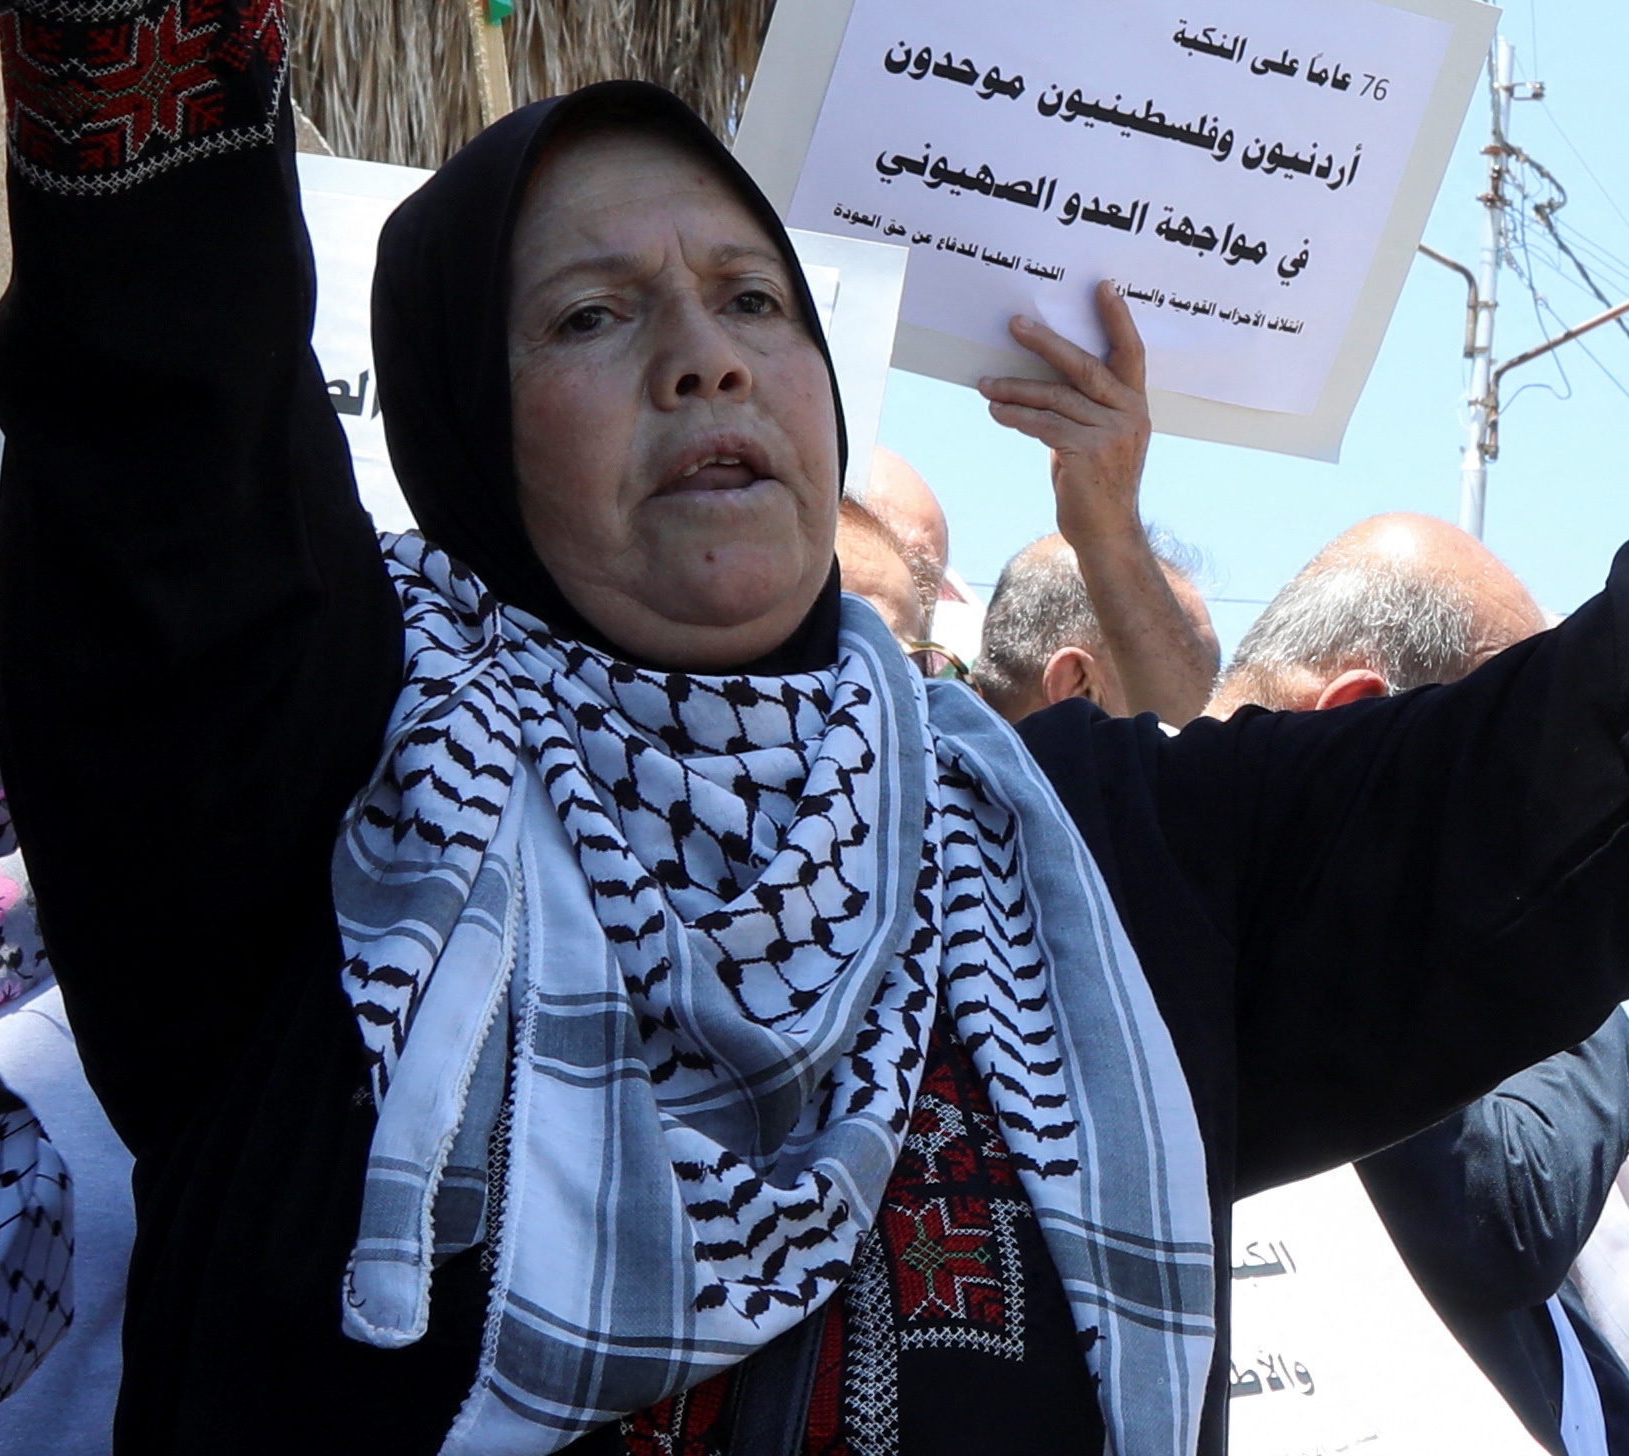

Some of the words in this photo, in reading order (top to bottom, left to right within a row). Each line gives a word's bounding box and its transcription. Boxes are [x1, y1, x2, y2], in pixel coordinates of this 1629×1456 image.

[1172, 19, 1248, 63] النكبة
[884, 41, 1026, 101] موحدون
[1250, 49, 1299, 77] على
[1360, 74, 1390, 101] 76
[1037, 83, 1234, 162] وفلسطينيون
[876, 143, 1058, 212] الصهيوني
[1242, 138, 1363, 190] أردنيون
[833, 203, 882, 229] العودة
[883, 219, 906, 236] حق
[1057, 192, 1150, 235] العدو
[911, 231, 932, 244] عن
[936, 236, 979, 258] للدفاع
[1155, 205, 1268, 266] مواجهة
[981, 247, 1021, 271] العليا
[1023, 258, 1065, 283] اللجنة
[1277, 238, 1310, 286] في
[1168, 292, 1217, 316] القومية
